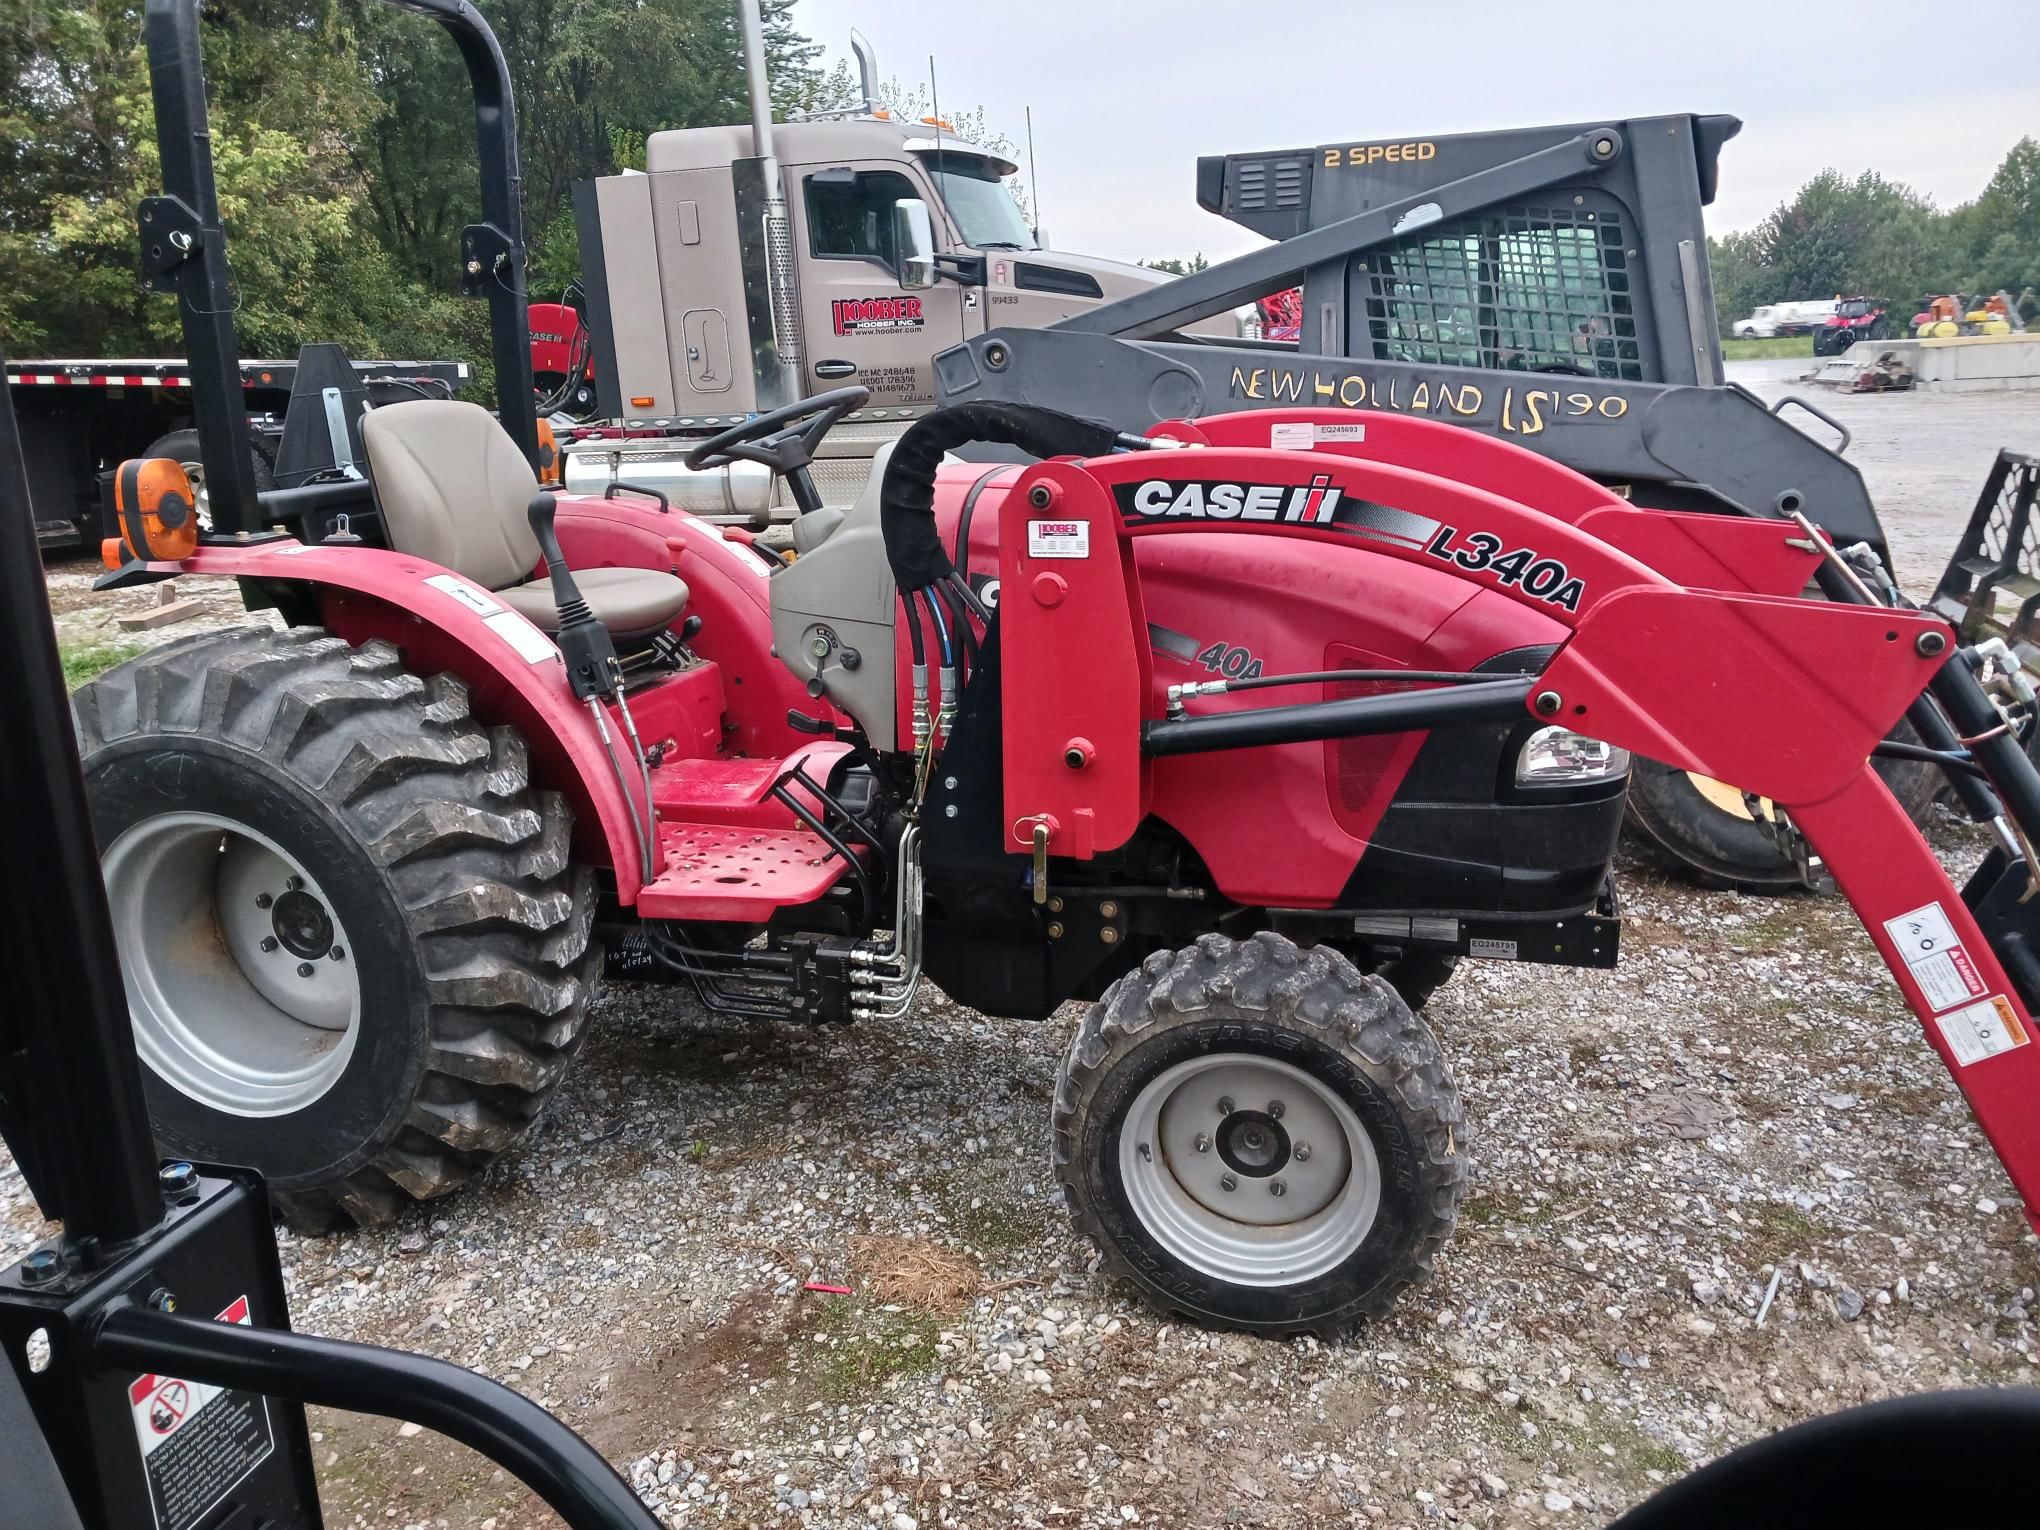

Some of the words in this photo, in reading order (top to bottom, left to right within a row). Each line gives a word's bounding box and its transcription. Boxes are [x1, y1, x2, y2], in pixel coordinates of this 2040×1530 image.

[1324, 149, 1341, 167] 2
[1348, 142, 1436, 165] SPEED
[832, 296, 924, 337] HOOBER
[854, 326, 922, 336] www.hoober.com
[857, 321, 895, 329] HOOBER
[897, 319, 916, 327] INC.
[1231, 366, 1304, 402] NEW
[1315, 373, 1482, 414] HOLLAND
[1133, 480, 1283, 520] CASE
[1427, 527, 1587, 612] L340A
[1196, 641, 1263, 680] 40A
[1954, 958, 1981, 992] DANGER
[148, 1452, 158, 1462] TO
[158, 1436, 176, 1454] AVOID
[177, 1411, 204, 1437] POSSIBLE
[205, 1393, 225, 1413] INJURY
[150, 1452, 168, 1470] FROM
[173, 1424, 200, 1450] MACHINE
[201, 1400, 227, 1426] RUNAWAY
[190, 1429, 207, 1446] engine
